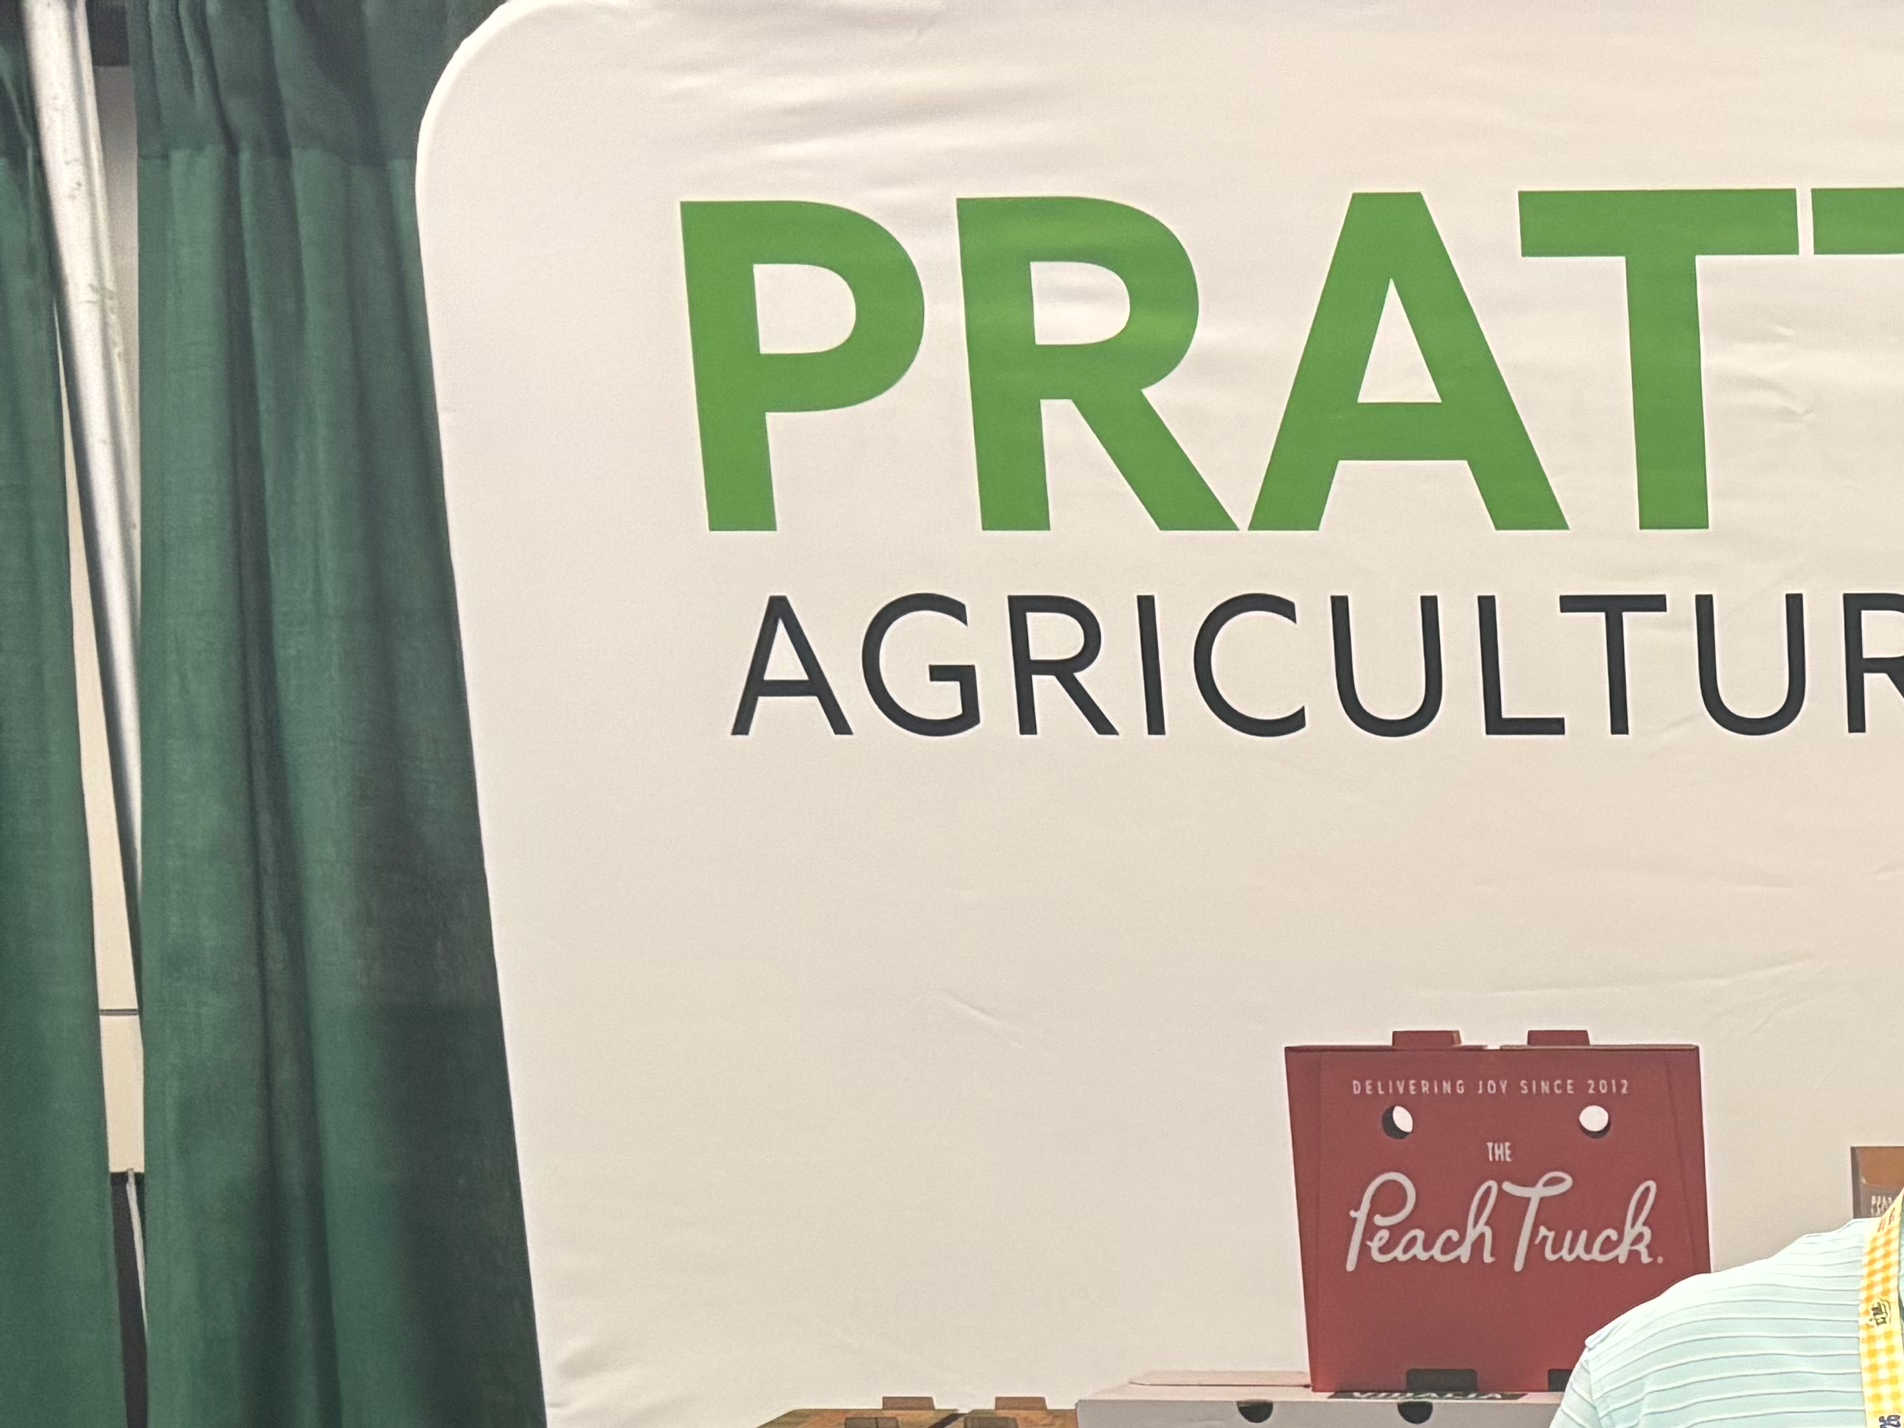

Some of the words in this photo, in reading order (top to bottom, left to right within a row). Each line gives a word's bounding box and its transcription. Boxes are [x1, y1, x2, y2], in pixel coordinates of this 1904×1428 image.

[1352, 1079, 1466, 1095] DELIVERING
[1477, 1079, 1509, 1095] JOY
[1519, 1079, 1576, 1095] SINCE
[1586, 1079, 1630, 1095] 2012
[1485, 1141, 1513, 1162] THE
[1346, 1172, 1499, 1272] Peach
